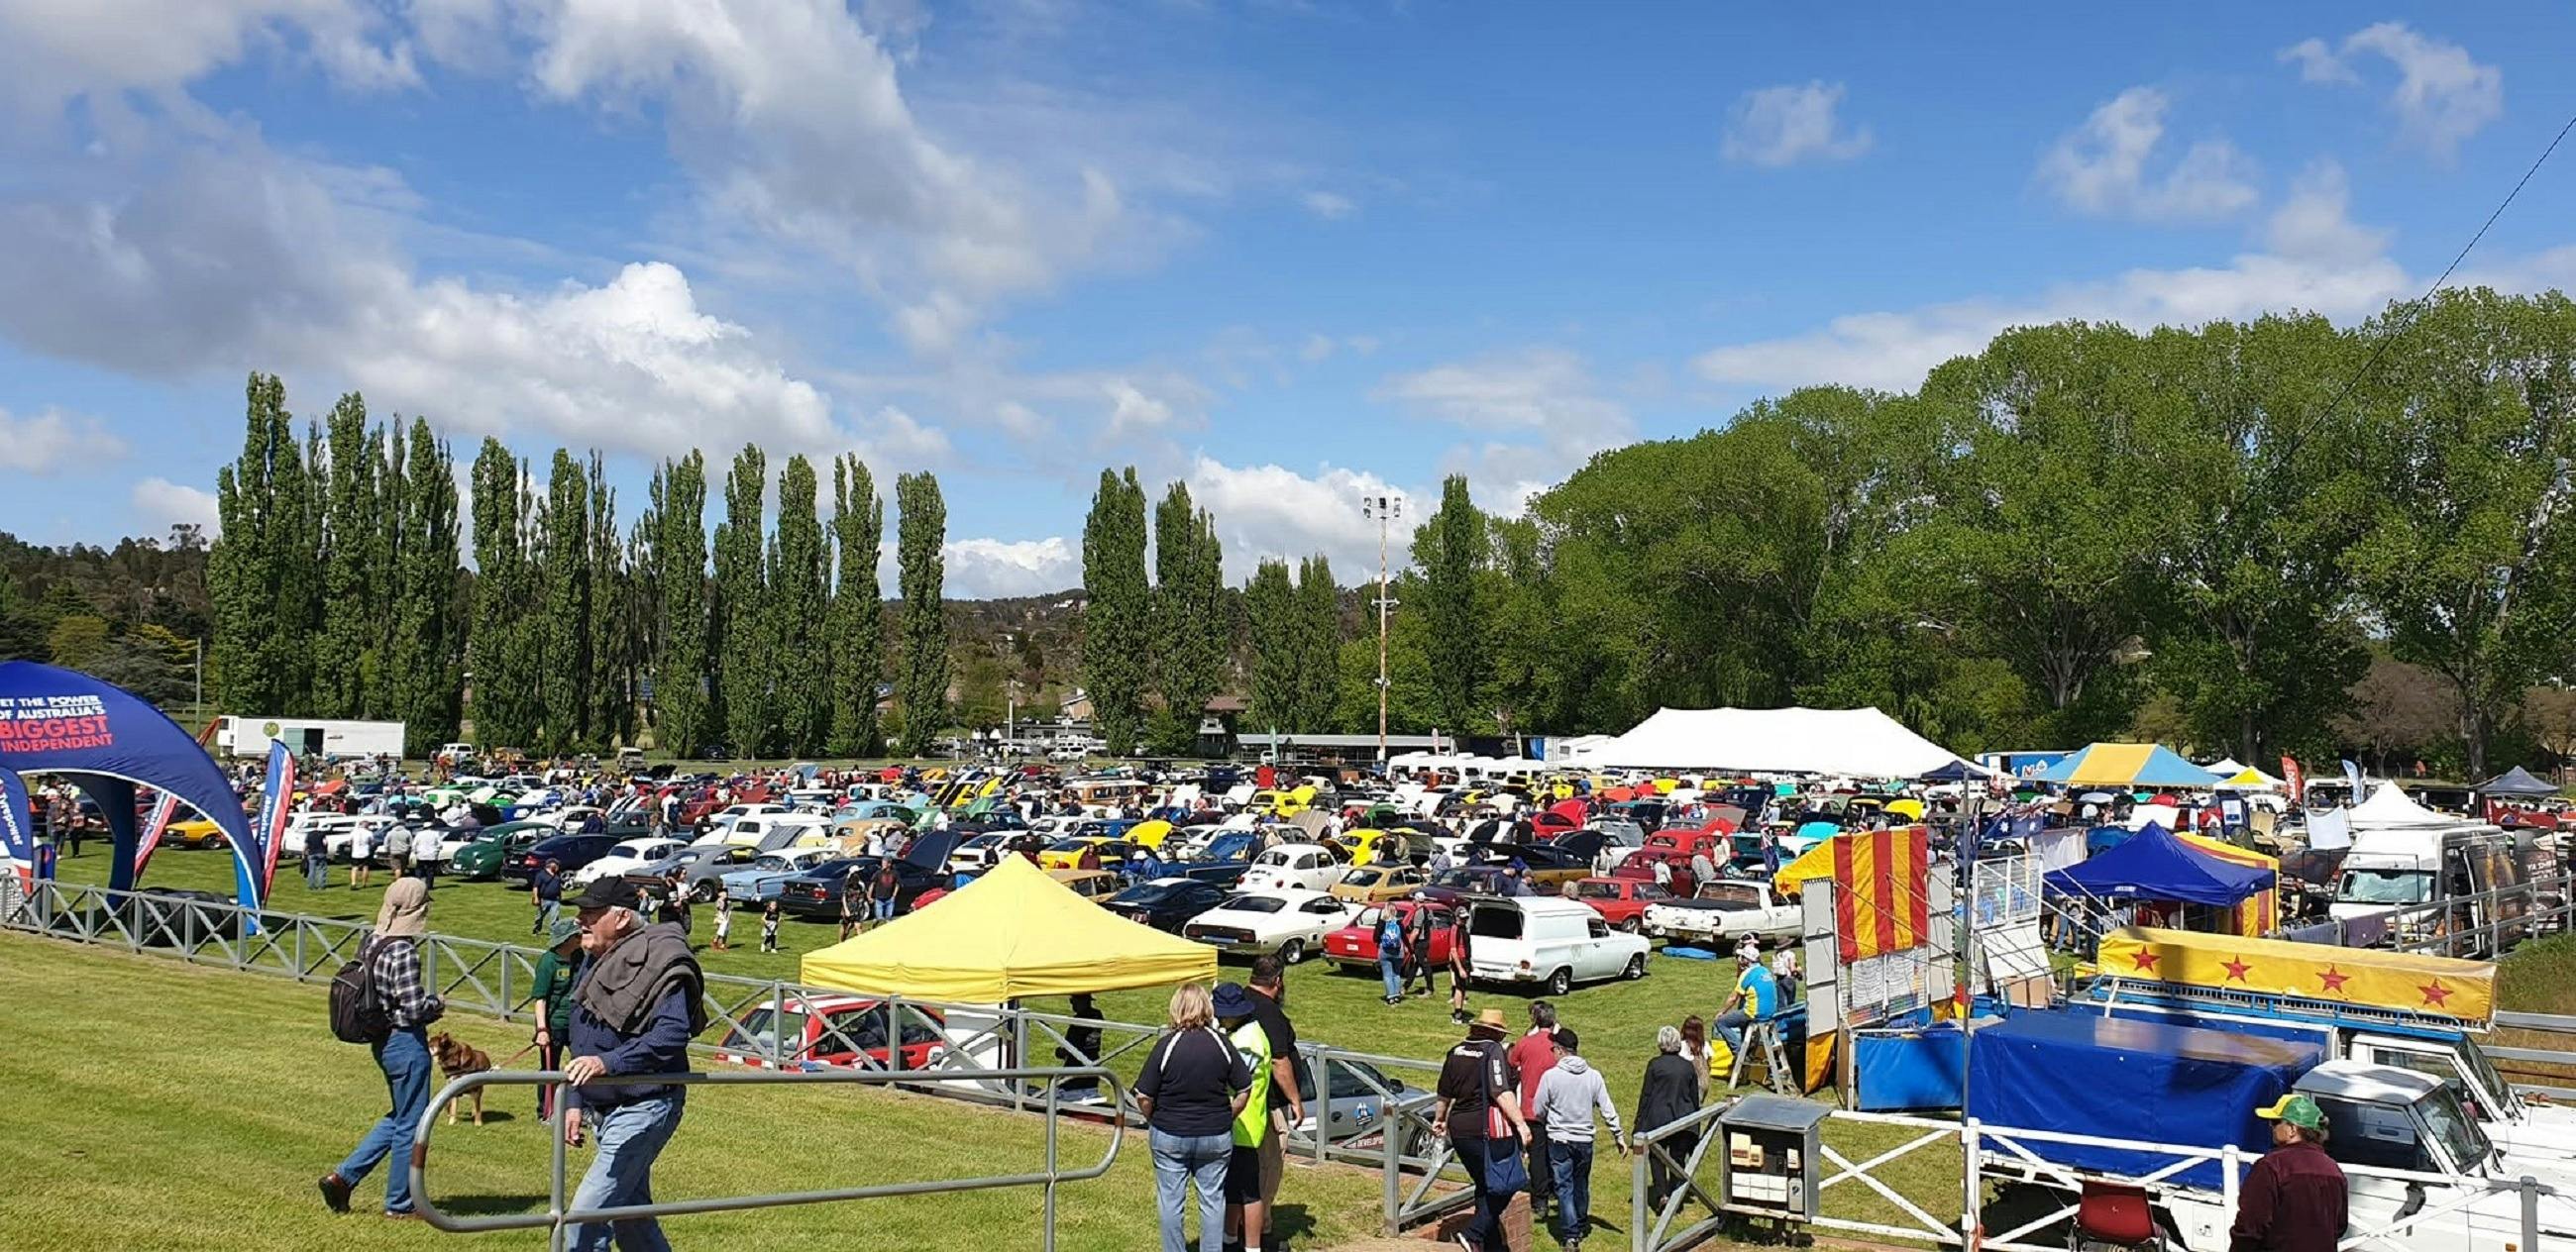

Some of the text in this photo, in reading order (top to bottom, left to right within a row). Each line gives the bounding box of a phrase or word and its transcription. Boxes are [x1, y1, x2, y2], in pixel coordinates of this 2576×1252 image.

[18, 697, 46, 706] THE
[47, 695, 102, 708] POWER
[0, 705, 105, 720] OF AUSTRALIA'S
[0, 715, 108, 739] BIGGEST
[1, 734, 112, 752] INDEPENDENT
